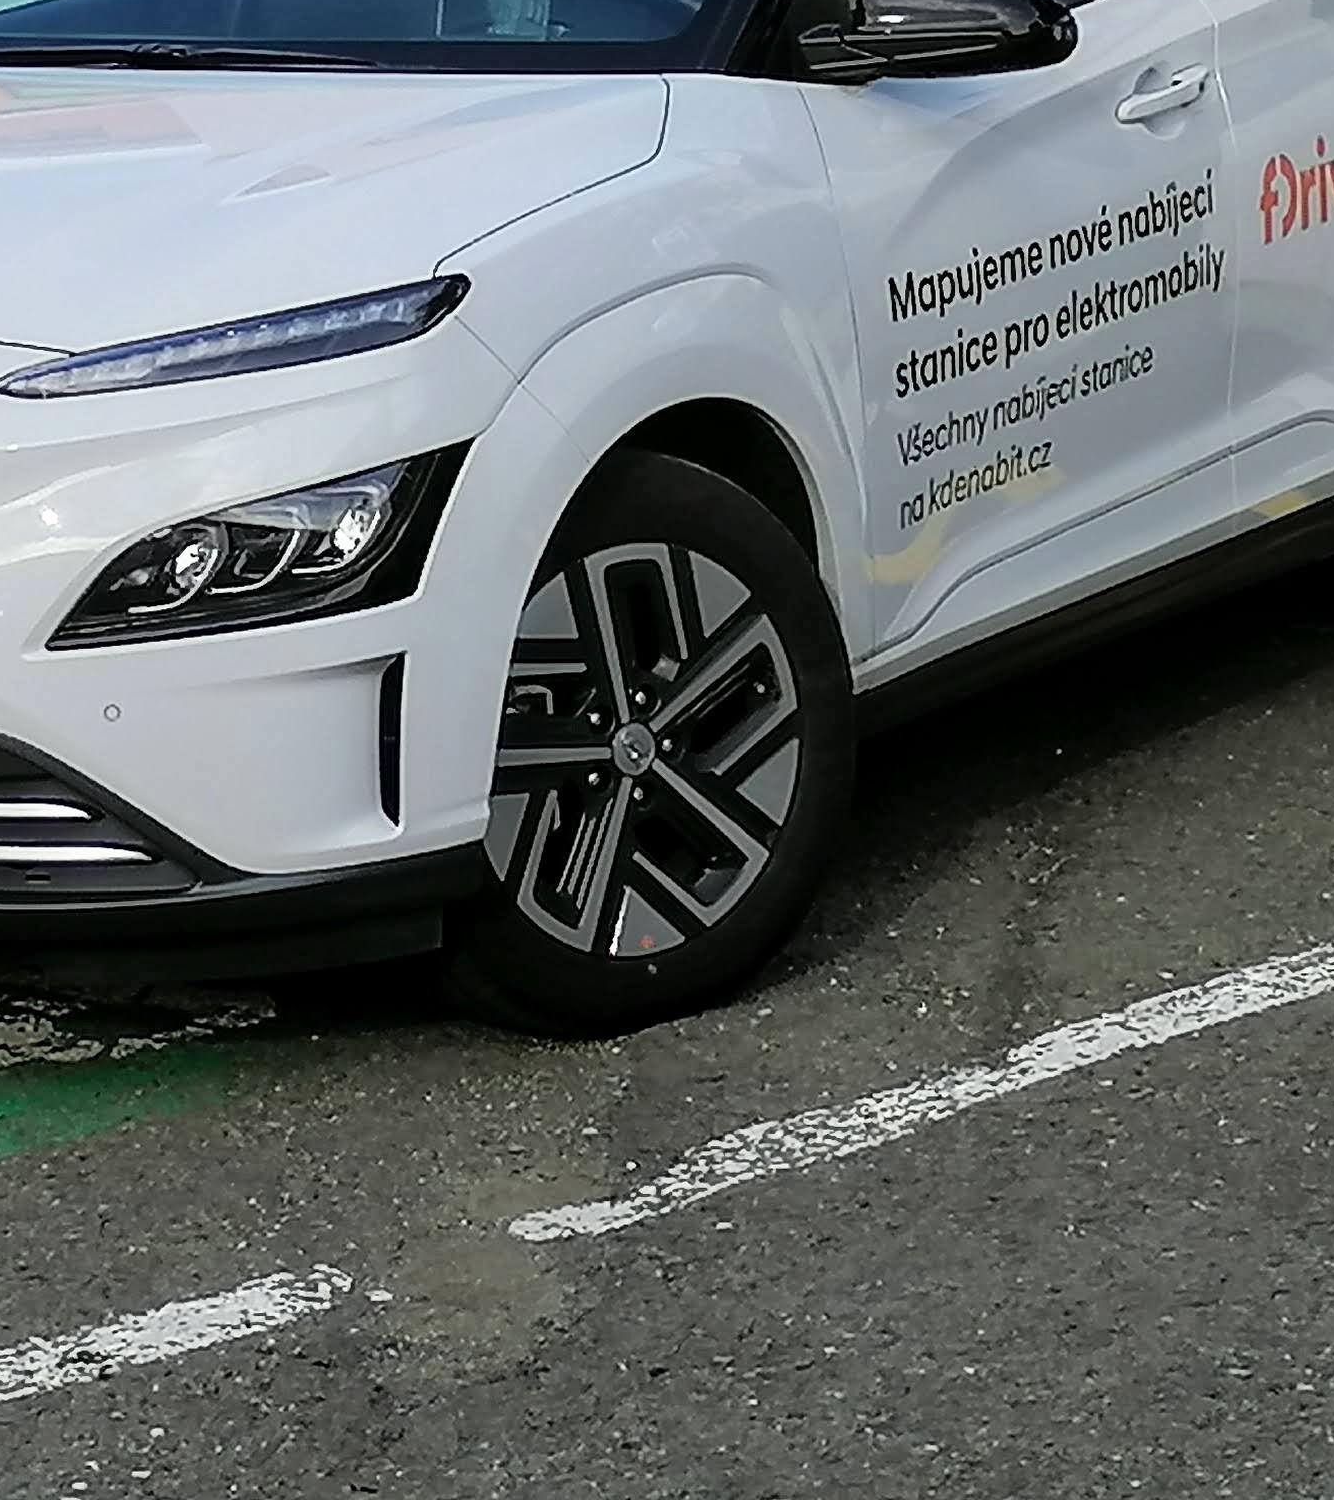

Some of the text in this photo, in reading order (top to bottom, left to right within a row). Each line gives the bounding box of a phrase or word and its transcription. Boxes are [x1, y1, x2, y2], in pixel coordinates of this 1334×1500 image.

[888, 168, 1214, 323] Mapujeme nové nabíjecí
[895, 250, 1225, 399] stanice pro elektromobily
[897, 344, 1154, 467] Všechny nabíjecí stanice
[899, 440, 1053, 529] na kdenabit.cz
